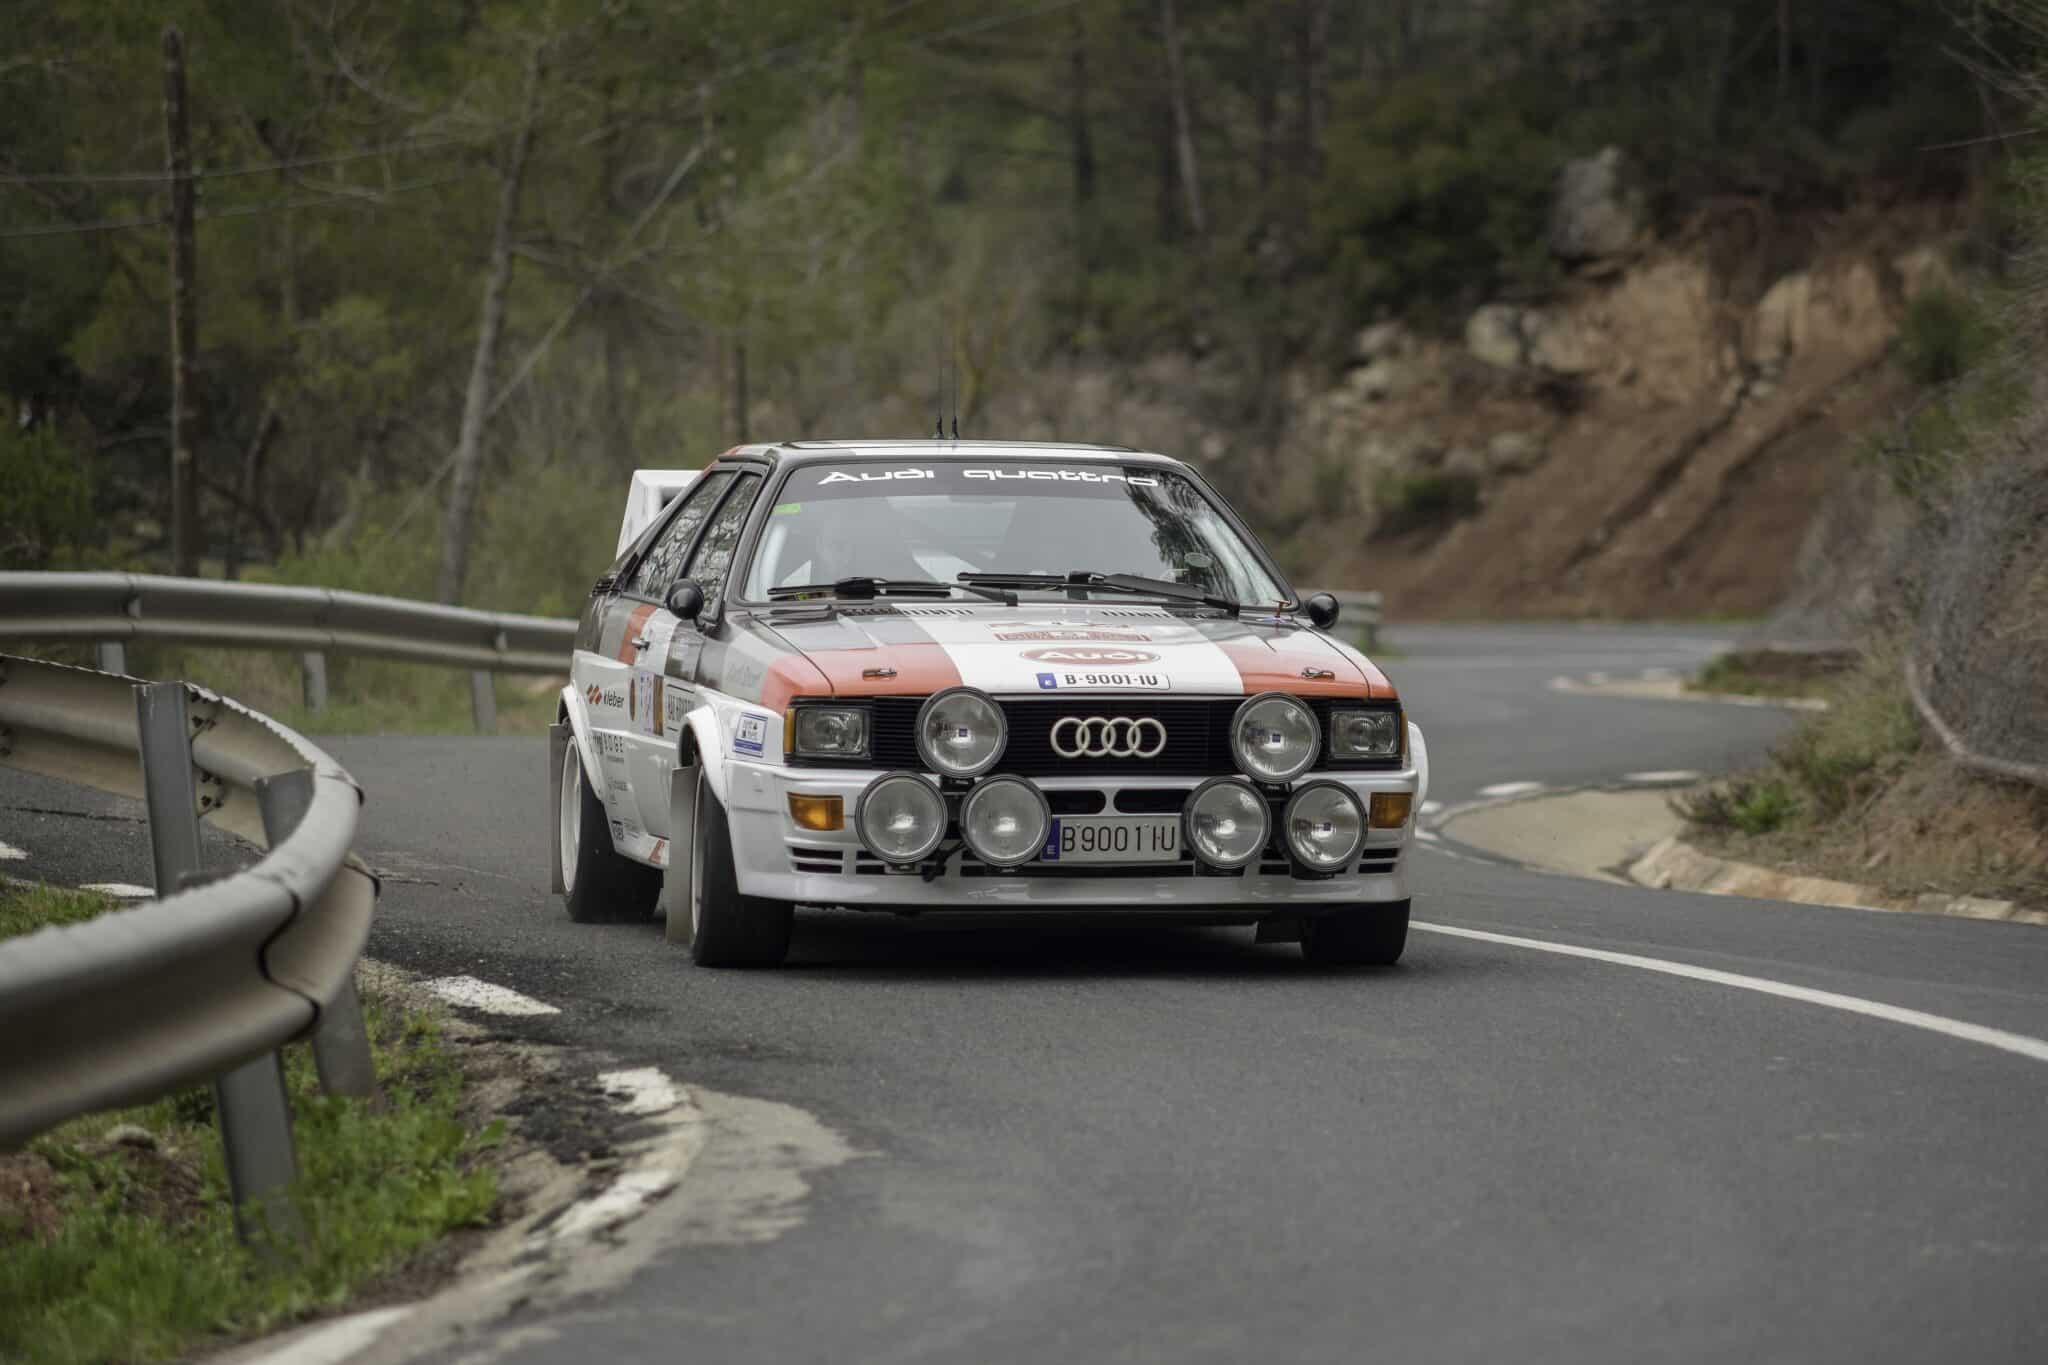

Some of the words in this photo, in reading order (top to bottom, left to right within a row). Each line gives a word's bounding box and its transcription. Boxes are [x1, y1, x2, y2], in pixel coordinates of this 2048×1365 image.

[817, 467, 935, 485] Audi
[963, 468, 1158, 487] quattro
[603, 690, 625, 708] kleber
